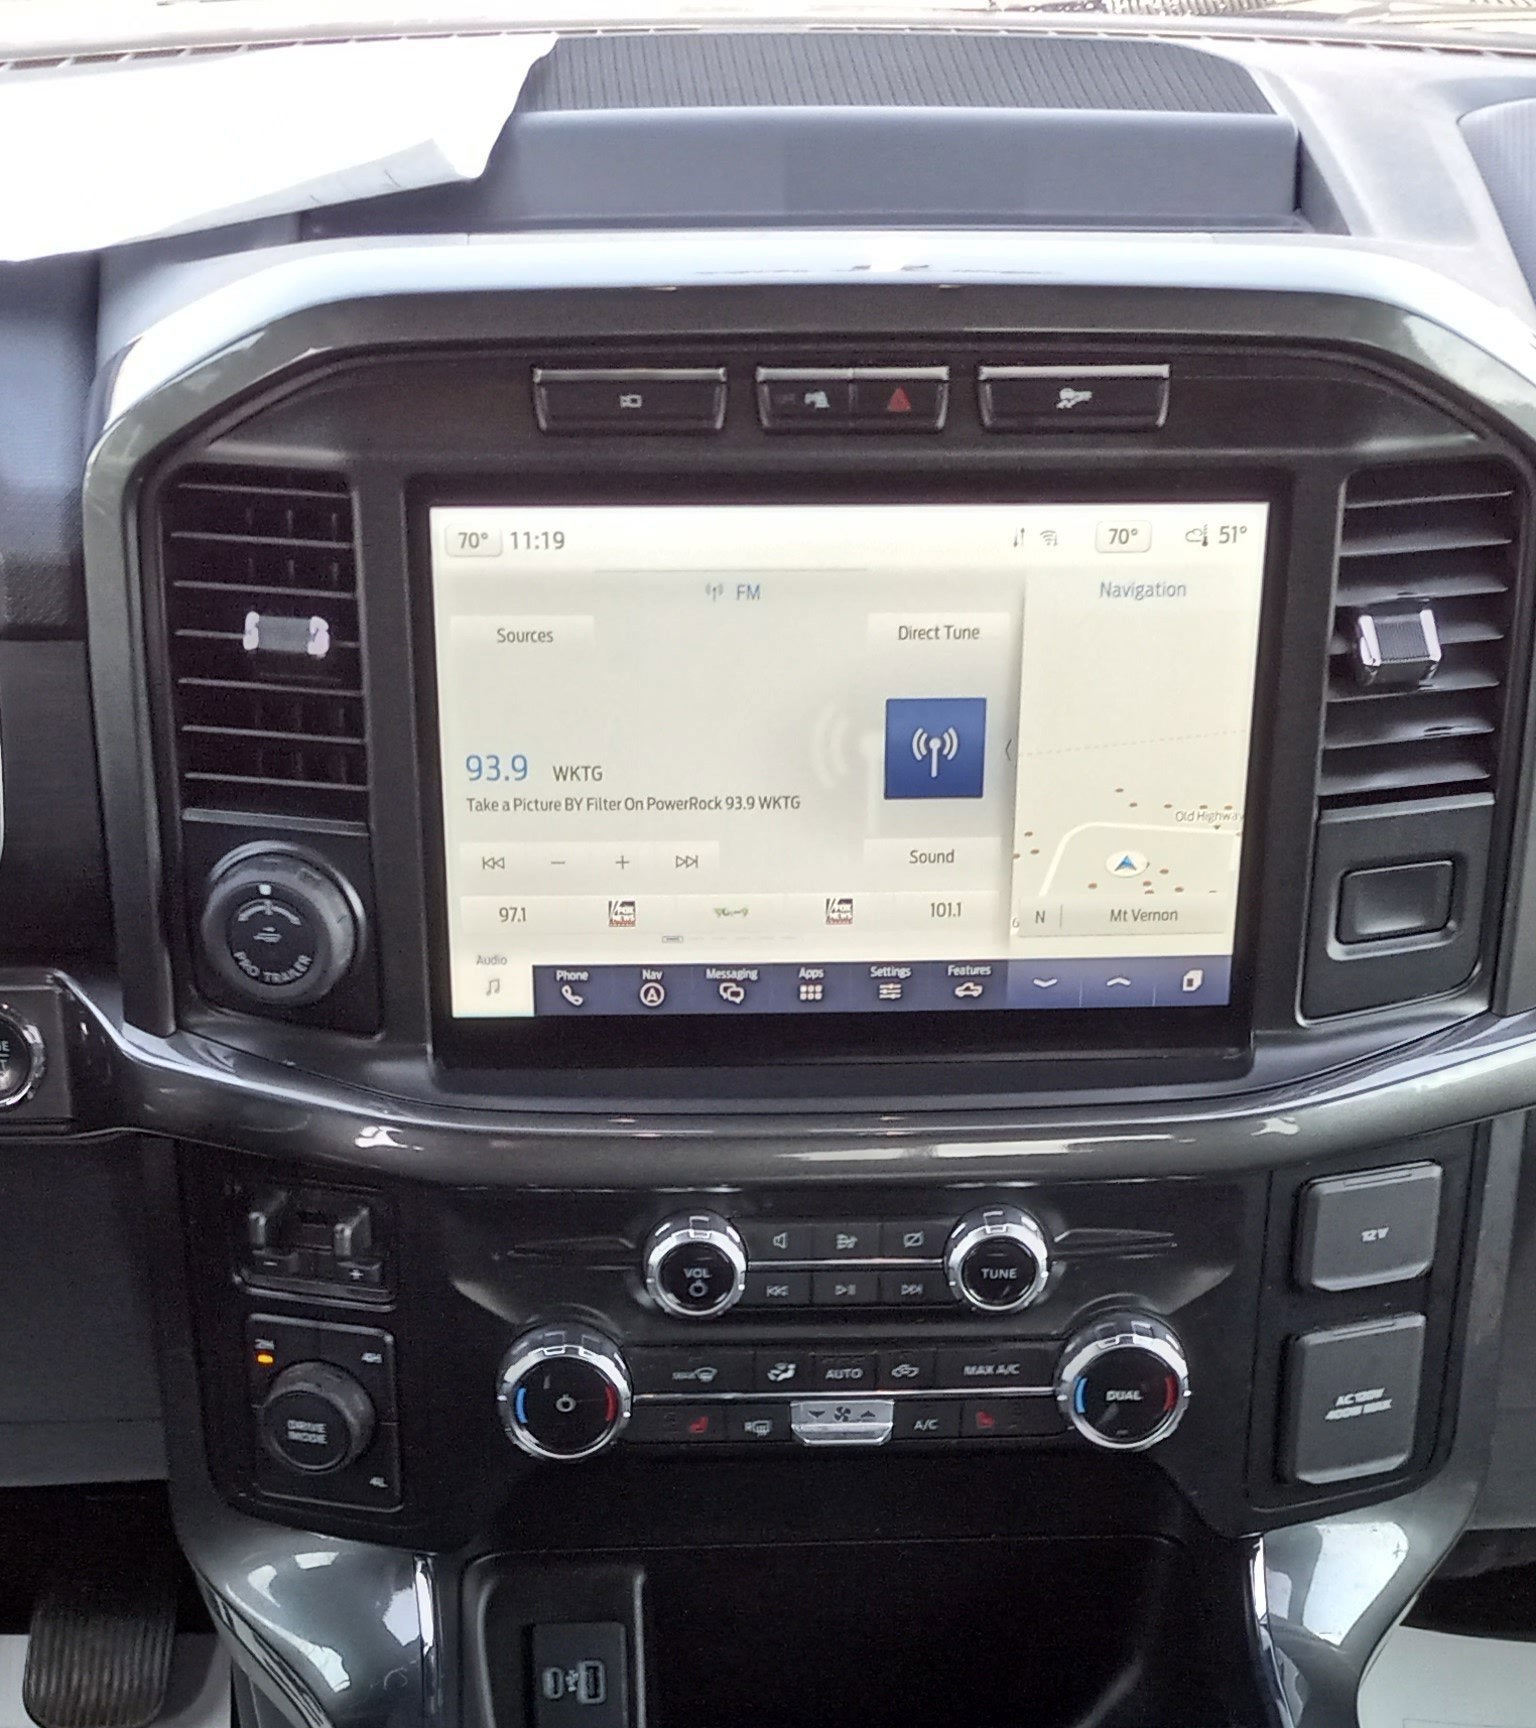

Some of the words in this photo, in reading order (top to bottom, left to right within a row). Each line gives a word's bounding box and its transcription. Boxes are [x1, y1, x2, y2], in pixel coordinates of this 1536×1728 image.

[510, 531, 565, 550] 11:19
[736, 585, 761, 600] FM
[1100, 581, 1187, 600] Navigation
[497, 628, 554, 644] Sources
[898, 625, 941, 641] Direct
[944, 625, 981, 640] Tune
[465, 754, 529, 782] 93.9
[552, 766, 603, 782] WKTG
[467, 797, 499, 813] Take
[502, 801, 511, 812] a
[513, 797, 562, 813] Picture
[565, 797, 583, 812] BY
[586, 796, 621, 812] Filter
[624, 796, 644, 812] On
[647, 795, 722, 812] PowerRock
[725, 795, 755, 811] 93.9
[759, 795, 801, 811] WKTG
[909, 849, 955, 865] Sound
[499, 907, 527, 923] 97.1
[931, 902, 962, 918] 101.1
[1035, 910, 1045, 924] N
[1110, 908, 1127, 923] Mt
[1131, 908, 1178, 923] Vernon
[476, 954, 508, 966] Audio
[556, 969, 589, 983] Phone
[642, 969, 663, 981] Nav
[706, 967, 759, 982] Messaging
[798, 967, 825, 981] Apps
[870, 965, 912, 979] Settings
[947, 964, 992, 977] Features
[683, 1268, 711, 1278] VOL
[981, 1268, 1017, 1280] TUNE
[825, 1367, 863, 1380] AUTO
[964, 1365, 994, 1376] MAX
[1106, 1389, 1143, 1401] DUAL
[914, 1418, 940, 1431] A/C
